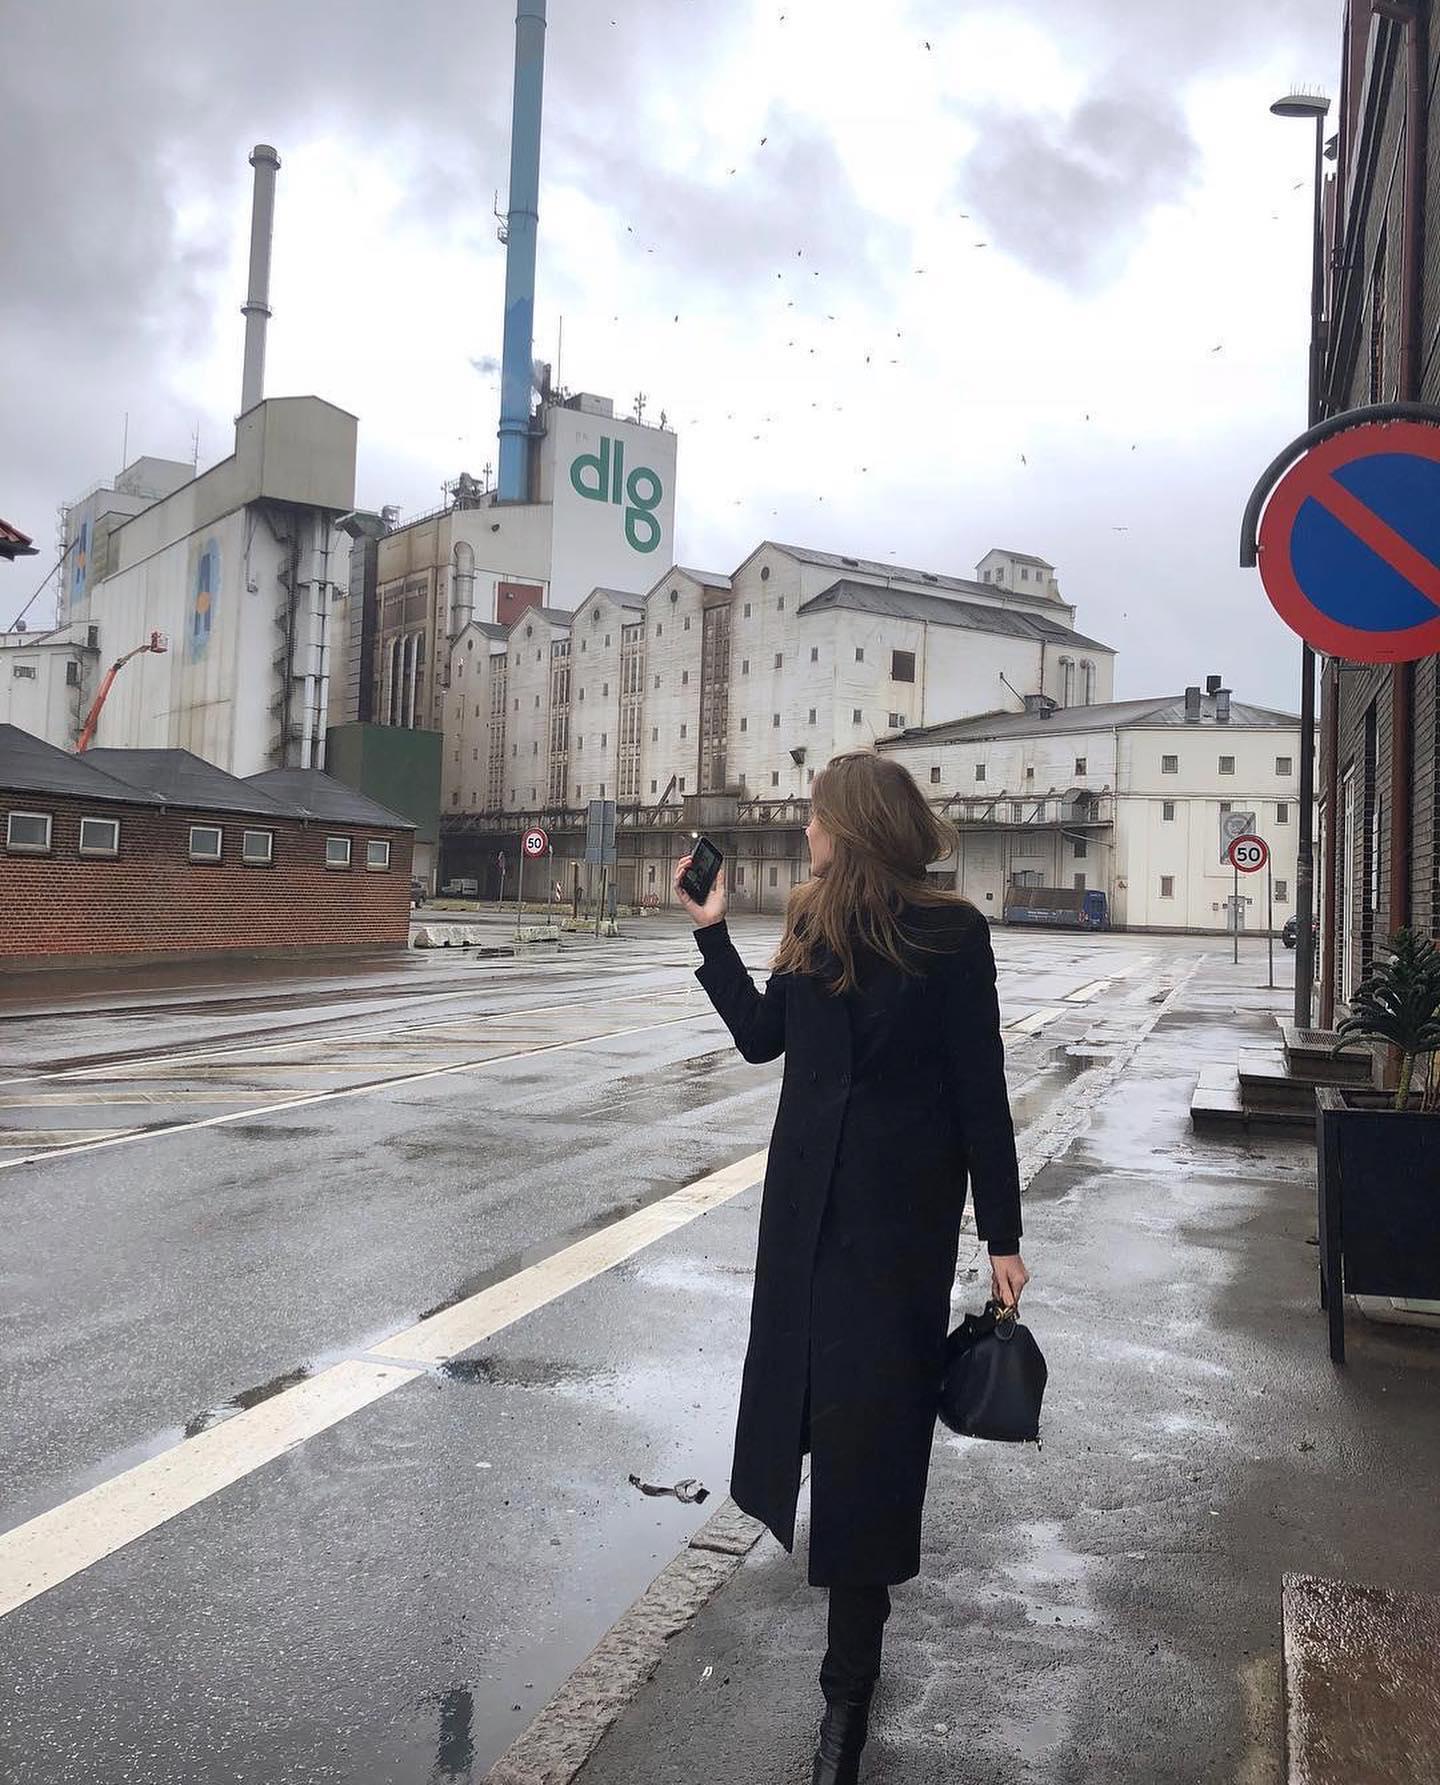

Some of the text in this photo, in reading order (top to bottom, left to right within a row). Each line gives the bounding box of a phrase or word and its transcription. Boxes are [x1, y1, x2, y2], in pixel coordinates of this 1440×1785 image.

[570, 436, 663, 554] dlg
[527, 838, 542, 849] 50
[1237, 847, 1261, 862] 50
